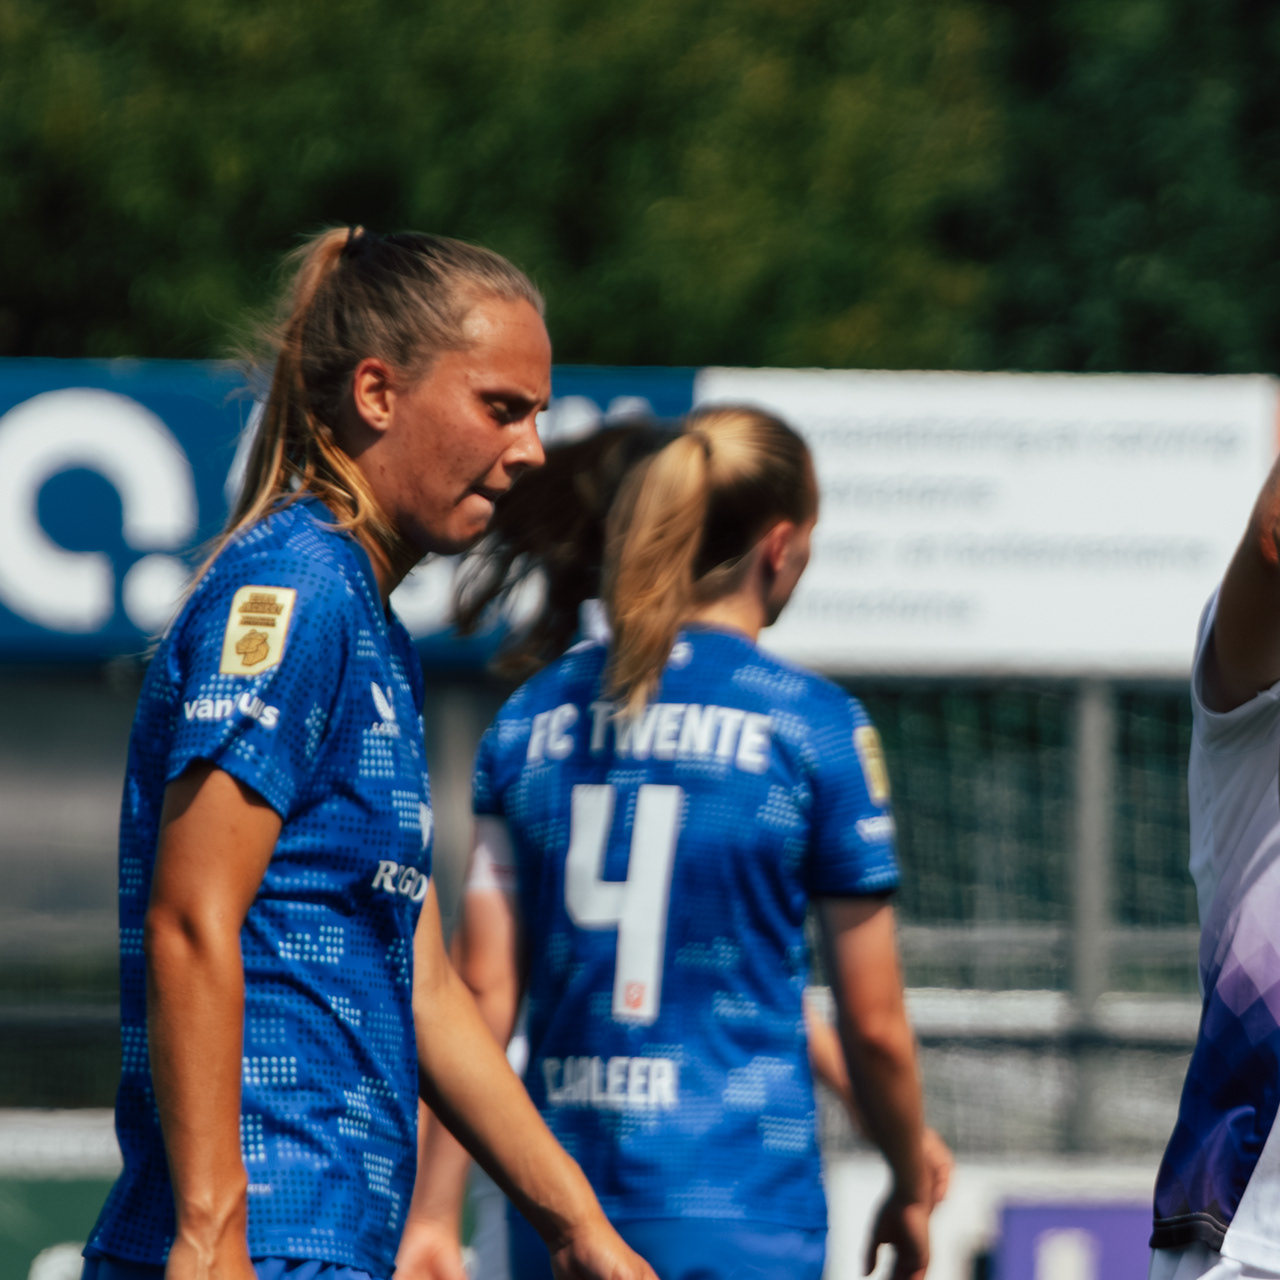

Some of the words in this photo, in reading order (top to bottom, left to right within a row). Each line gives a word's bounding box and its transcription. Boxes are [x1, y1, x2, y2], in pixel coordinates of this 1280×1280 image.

[526, 703, 580, 764] FC
[589, 702, 773, 774] TWENTE
[565, 783, 685, 1025] 4
